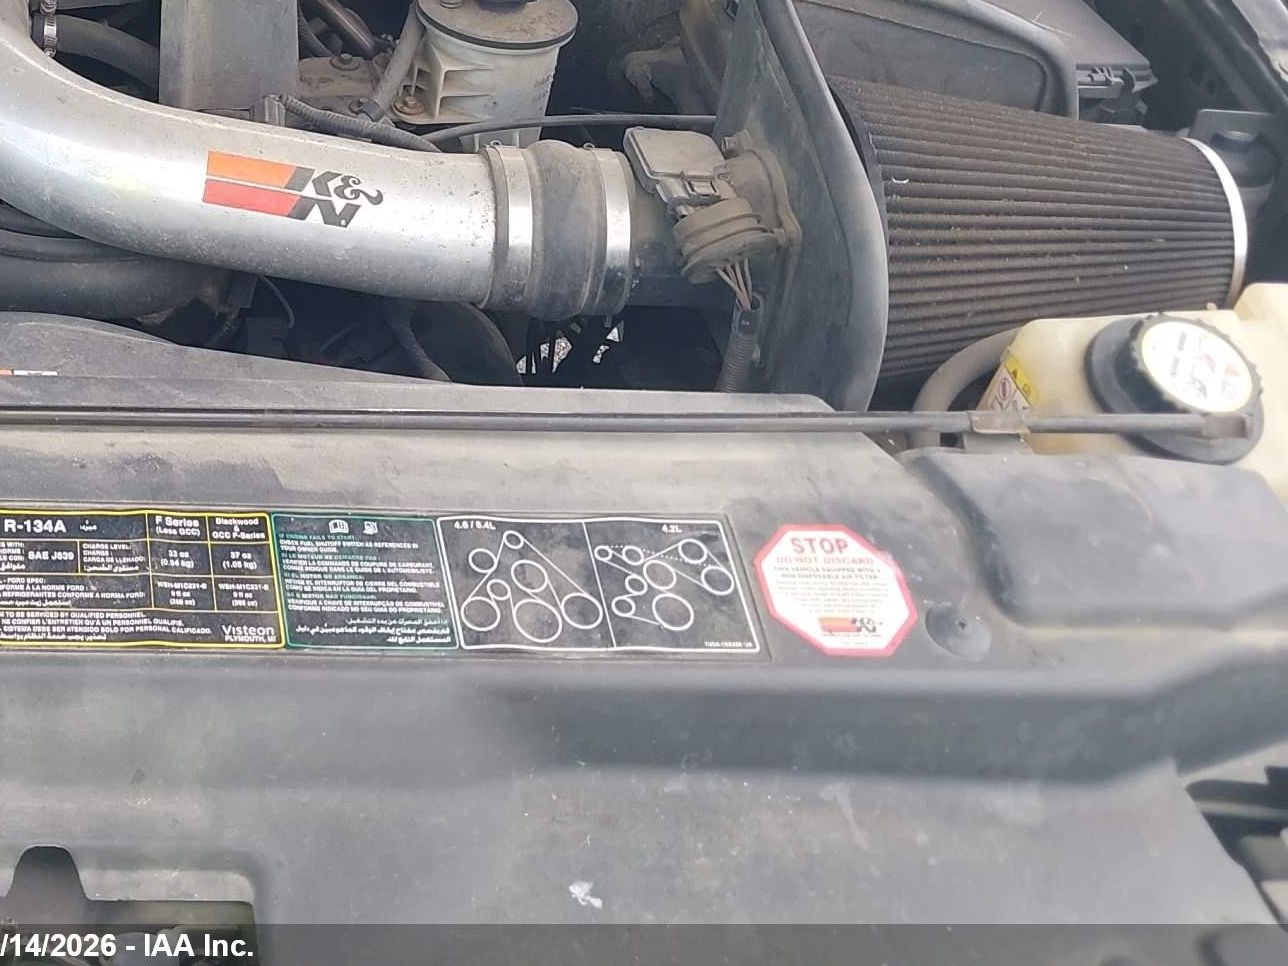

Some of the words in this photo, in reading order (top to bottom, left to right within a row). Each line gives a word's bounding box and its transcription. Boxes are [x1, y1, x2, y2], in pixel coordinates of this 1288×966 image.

[4, 519, 67, 533] R-134A
[155, 515, 162, 524] F
[165, 517, 200, 528] Series
[215, 517, 260, 525] Blackwood
[790, 537, 849, 555] STOP
[28, 551, 49, 560] SAE
[51, 551, 75, 560] J639
[222, 624, 275, 636] Visteon
